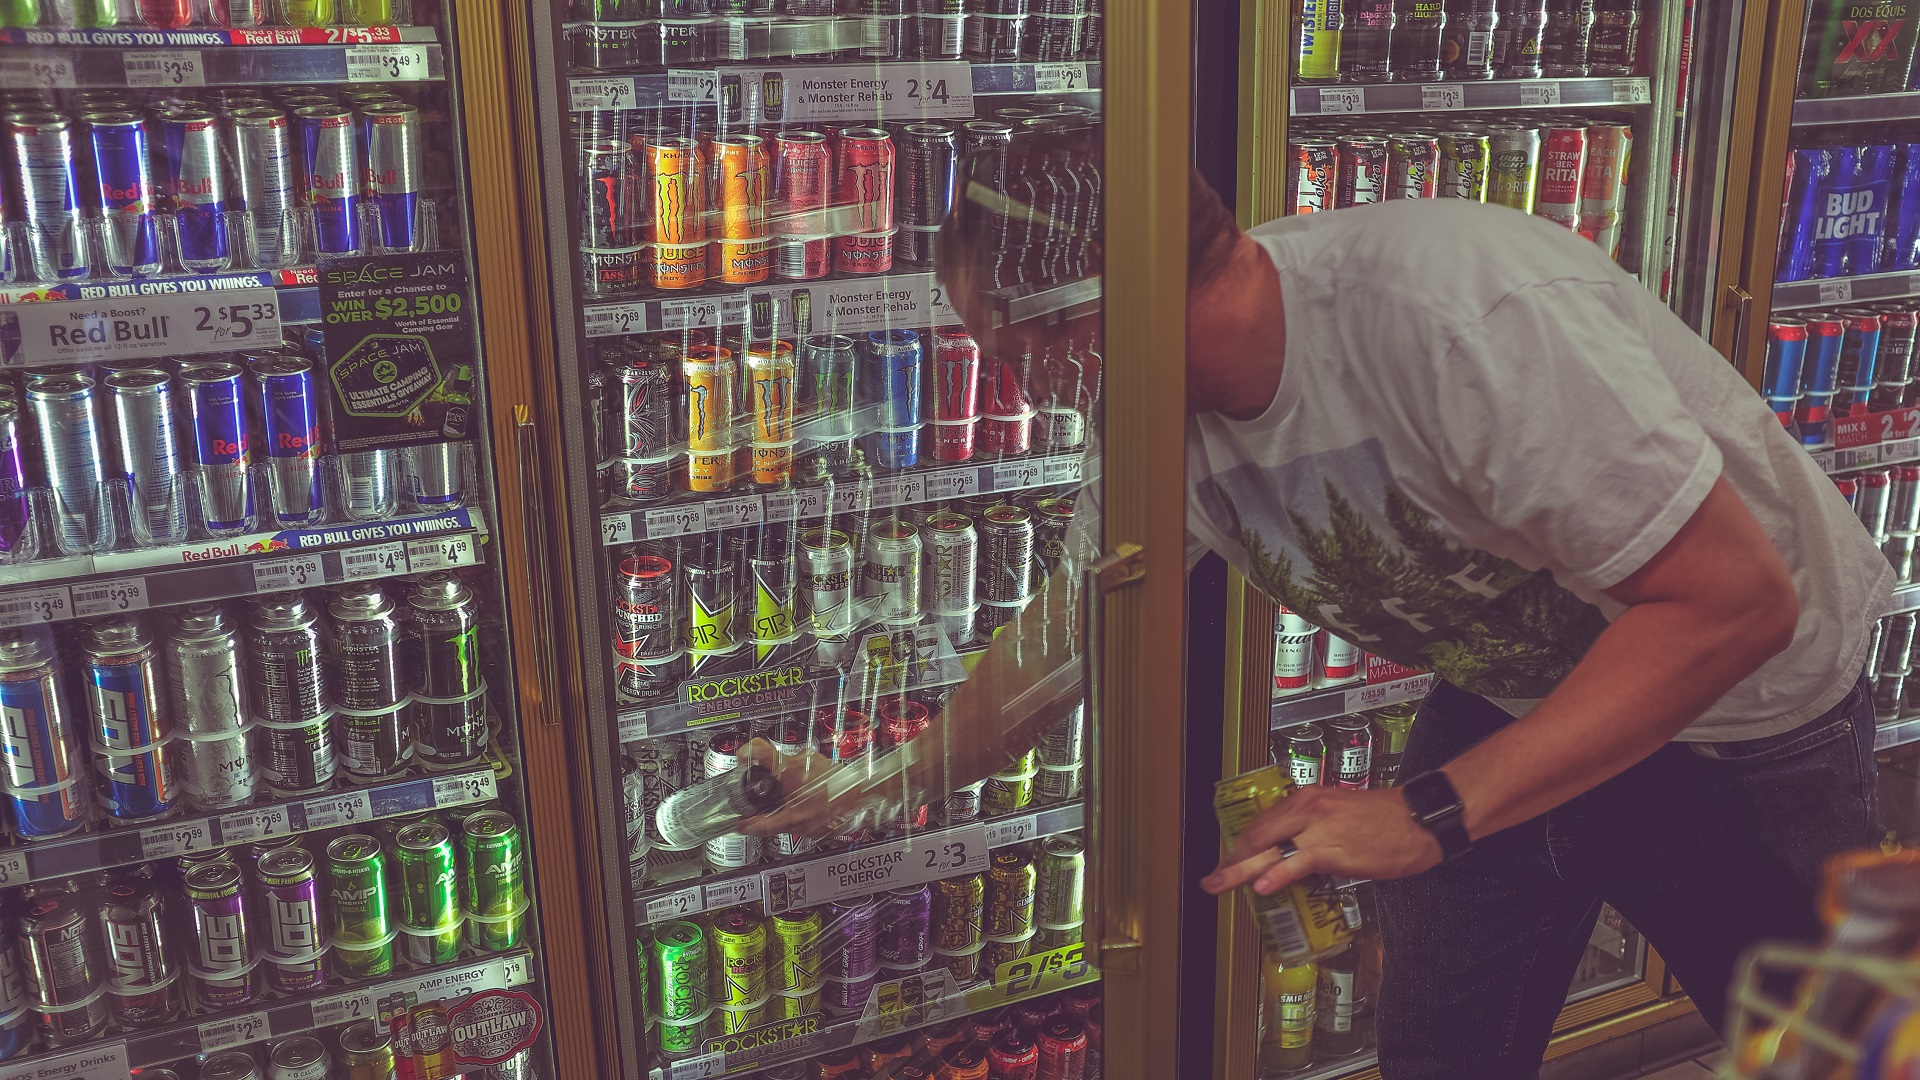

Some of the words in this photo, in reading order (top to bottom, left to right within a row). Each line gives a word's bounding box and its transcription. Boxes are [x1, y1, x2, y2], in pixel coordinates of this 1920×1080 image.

[1851, 6, 1873, 19] DOS
[1875, 4, 1906, 18] EQUIS
[26, 31, 55, 45] RED
[60, 31, 91, 45] BULL
[92, 31, 133, 45] GIVES
[134, 31, 171, 45] YOU
[174, 31, 224, 45] WIIINGS.
[245, 34, 272, 45] Red
[275, 34, 301, 44] Bull
[1681, 34, 1691, 70] ORIGINAL
[802, 79, 848, 90] Monster
[850, 79, 888, 92] Energy
[907, 78, 920, 98] 2
[925, 78, 950, 104] $4
[798, 95, 805, 104] &
[808, 93, 857, 103] Monster
[858, 91, 893, 102] Rehab
[1493, 161, 1526, 172] LIGHT
[1499, 154, 1524, 165] BUD
[1549, 151, 1581, 163] STRAW
[1546, 168, 1580, 181] RITA
[1826, 189, 1874, 216] BUD
[1815, 212, 1881, 241] LIGHT
[327, 262, 404, 286] SPACE
[409, 262, 456, 278] JAM
[80, 286, 106, 299] RED
[109, 284, 140, 298] BULL
[141, 280, 178, 296] GIVES
[178, 277, 209, 293] YOU
[209, 273, 263, 291] WIIINGS.
[337, 289, 366, 299] Enter
[367, 288, 383, 297] for
[393, 284, 433, 295] Chance
[434, 283, 447, 292] to
[331, 300, 366, 313] WIN
[829, 292, 874, 305] Monster
[876, 290, 912, 304] Energy
[930, 287, 942, 307] 2
[70, 309, 97, 321] Need
[99, 311, 108, 320] a
[110, 306, 146, 318] Boost?
[326, 310, 374, 325] OVER
[374, 293, 462, 321] $2,500
[826, 309, 833, 318] &
[835, 305, 881, 317] Monster
[883, 302, 917, 314] Rehab
[49, 320, 107, 347] Red
[114, 315, 169, 342] Bull
[193, 306, 212, 332] 2
[213, 325, 232, 341] for
[395, 318, 414, 328] Worth
[424, 316, 460, 327] Essential
[402, 324, 435, 336] Camping
[436, 322, 454, 332] Gear
[57, 347, 75, 355] Offer
[104, 344, 112, 352] all
[113, 344, 122, 352] 12
[137, 341, 167, 351] Varieties
[339, 348, 390, 380] SPACE
[392, 343, 422, 355] JAM
[348, 382, 390, 401] ULTIMATE
[389, 366, 428, 391] CAMPING
[351, 391, 398, 410] ESSENTIALS
[396, 373, 433, 398] GIVEAWAY
[1837, 421, 1858, 434] MIX
[1860, 420, 1867, 431] &
[1881, 414, 1895, 438] 2
[213, 437, 247, 456] Red
[1837, 432, 1868, 445] MATCH
[299, 532, 324, 547] RED
[324, 528, 352, 544] BULL
[352, 524, 386, 541] GIVES
[386, 521, 415, 537] YOU
[416, 515, 462, 534] WIIINGS.
[182, 550, 210, 564] Red
[210, 545, 239, 560] Bull
[699, 696, 750, 714] ENERGY
[755, 687, 797, 705] DRINK
[1360, 687, 1386, 700] 2/$3.50
[827, 850, 903, 878] ROCKSTAR
[925, 849, 938, 869] 2
[943, 842, 967, 870] $3
[839, 865, 893, 888] ENERGY
[330, 886, 377, 901] AMP
[60, 921, 87, 942] NOS
[418, 978, 442, 991] AMP
[443, 968, 487, 986] ENERGY
[473, 1009, 508, 1022] ORIGINAL
[453, 1011, 528, 1043] OUTLAW
[471, 1030, 517, 1048] ENERGY
[37, 1061, 78, 1077] Energy
[80, 1053, 116, 1069] Drinks
